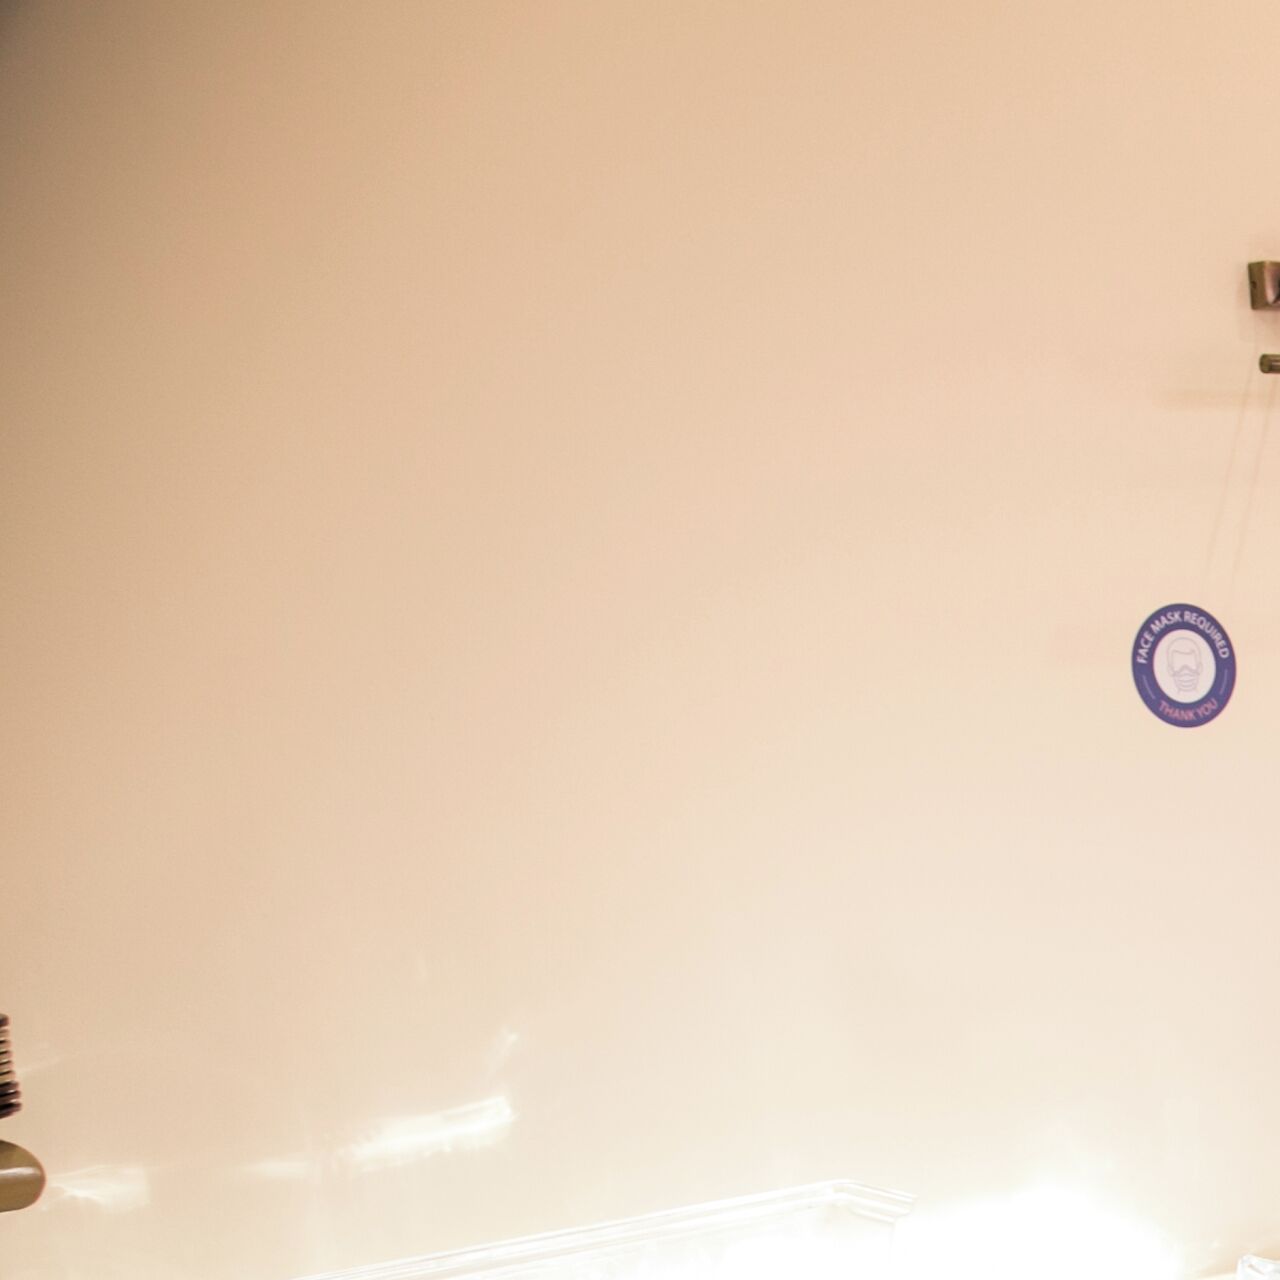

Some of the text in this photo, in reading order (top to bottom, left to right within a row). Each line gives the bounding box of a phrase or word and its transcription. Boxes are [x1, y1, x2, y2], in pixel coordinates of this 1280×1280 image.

[1136, 611, 1230, 664] FACE MASK REQUIRED
[1159, 698, 1219, 720] THANK YOU
